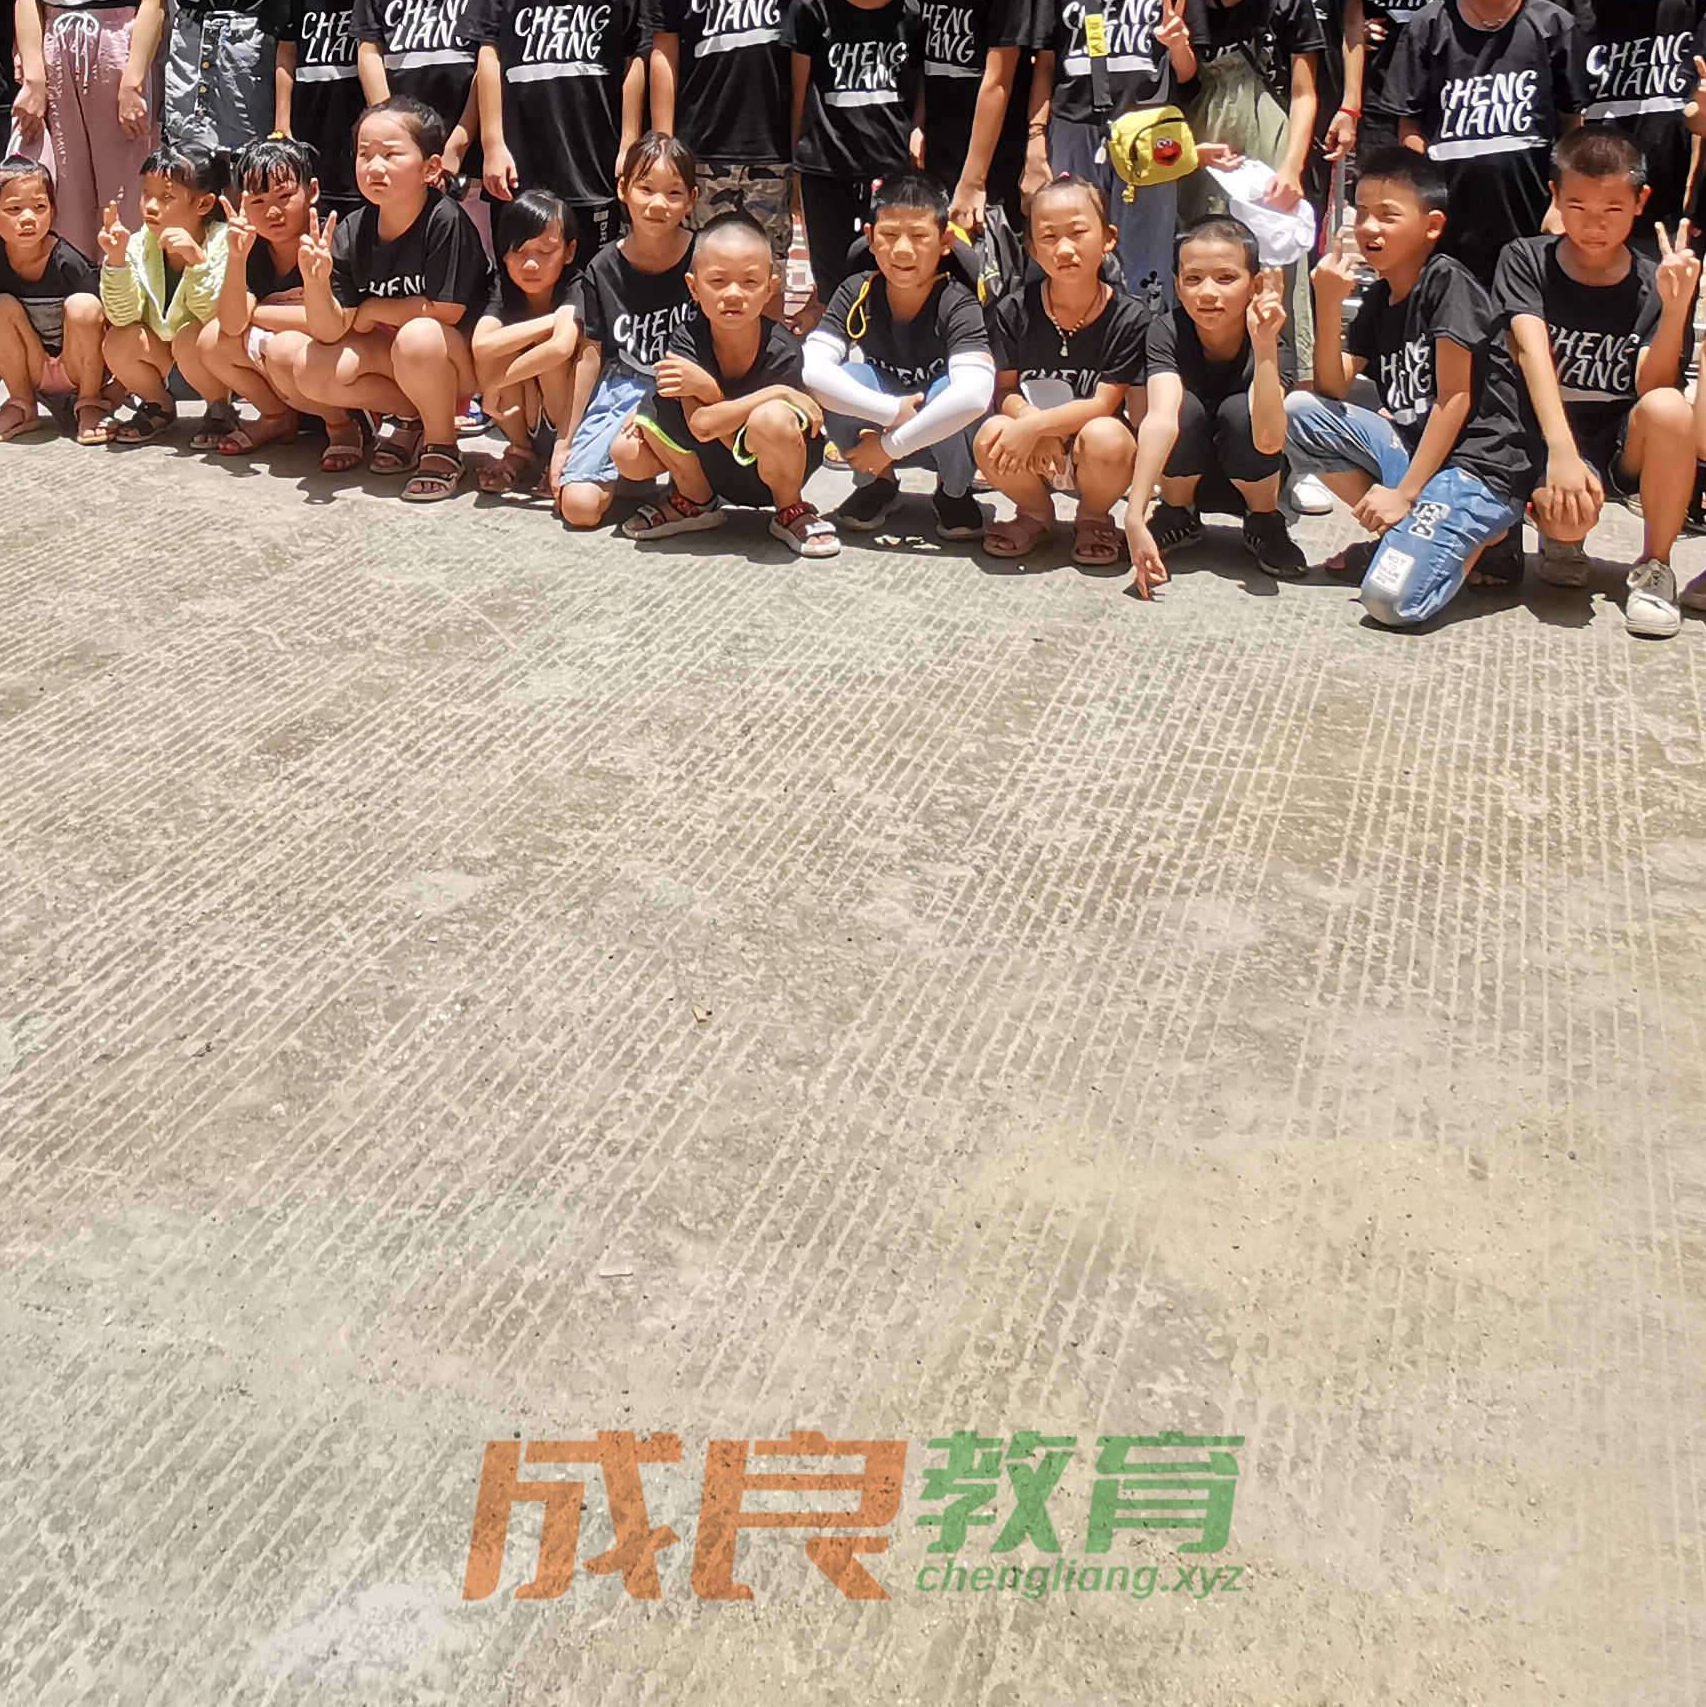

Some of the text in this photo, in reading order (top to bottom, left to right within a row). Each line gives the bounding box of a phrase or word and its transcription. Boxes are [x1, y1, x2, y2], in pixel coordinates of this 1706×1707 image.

[515, 4, 611, 37] CHENG
[523, 31, 604, 61] LIANG
[1441, 100, 1533, 139] LIANG
